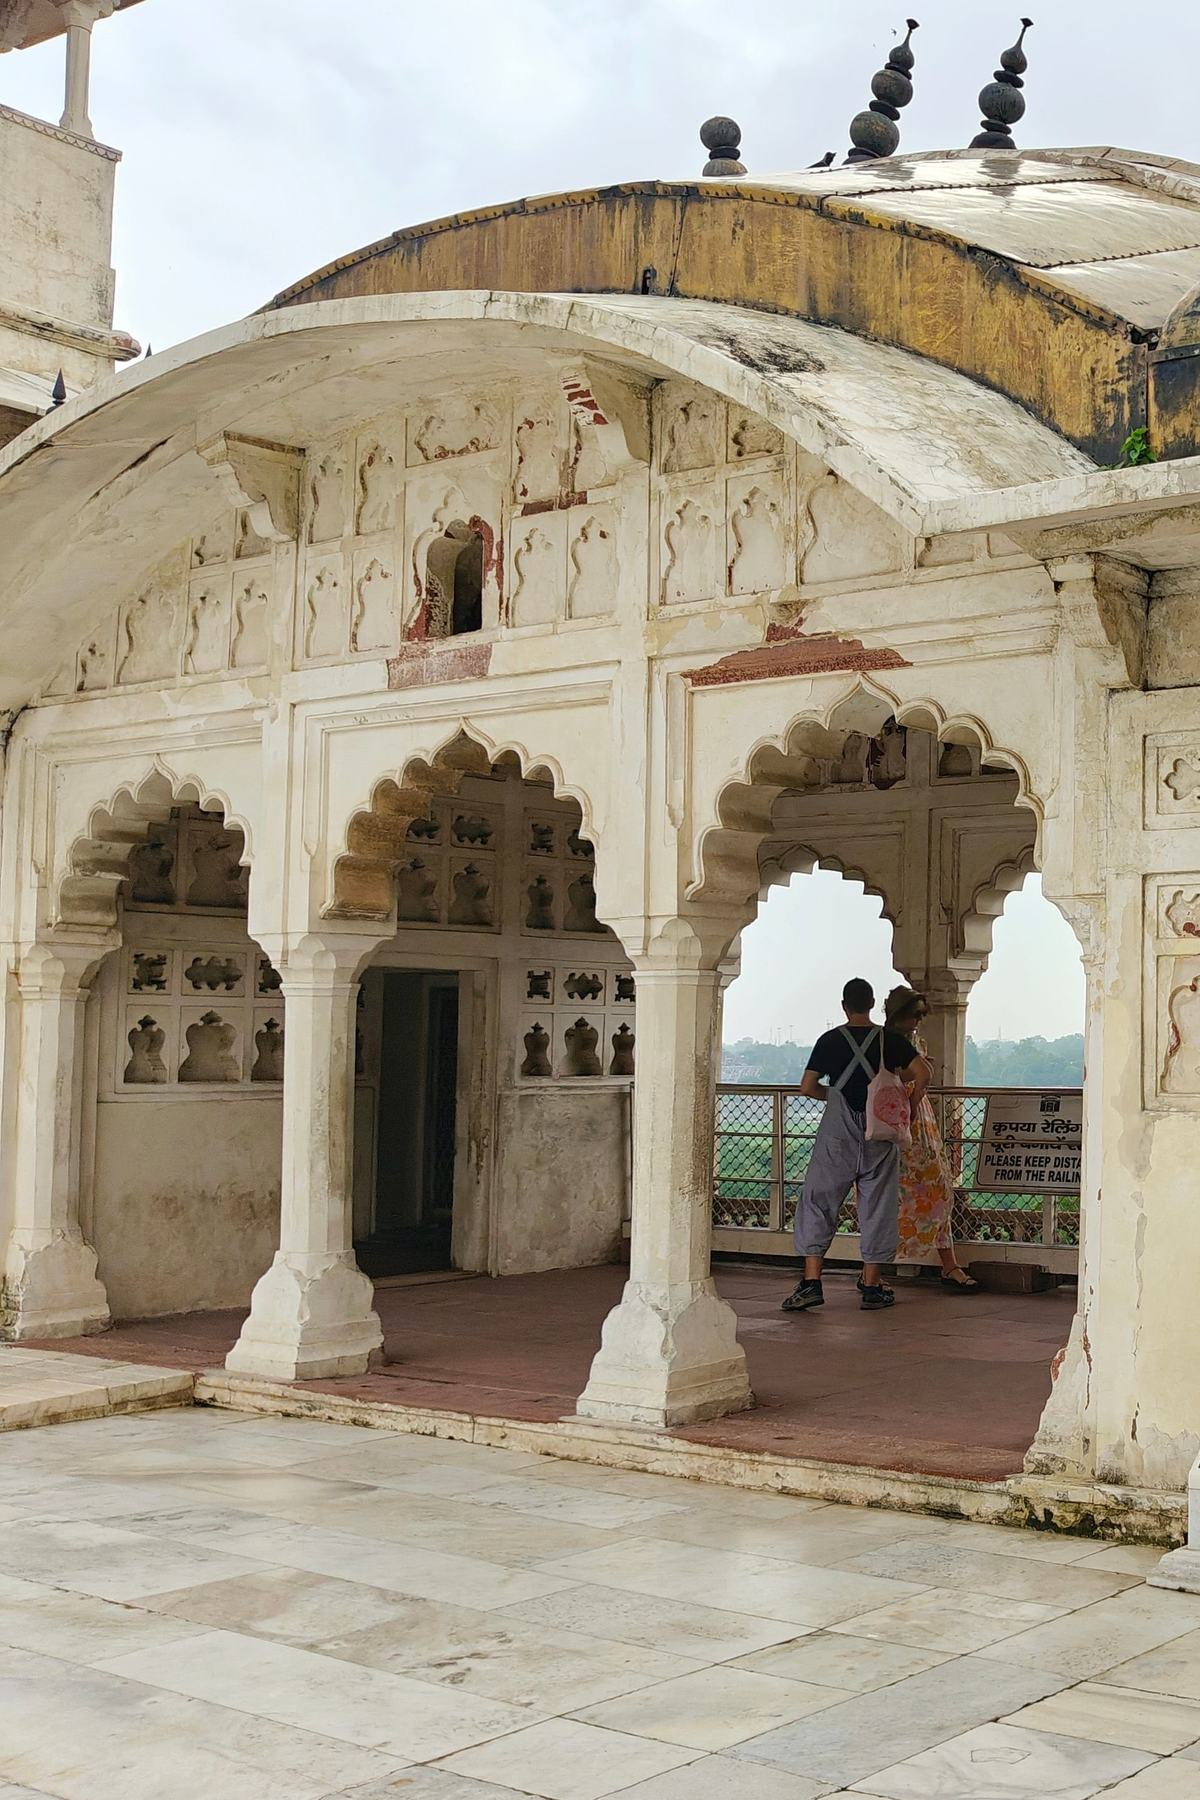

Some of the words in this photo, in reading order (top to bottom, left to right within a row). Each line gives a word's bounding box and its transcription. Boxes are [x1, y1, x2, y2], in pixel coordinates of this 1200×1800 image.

[992, 1122, 1037, 1136] कृपया
[985, 1155, 1021, 1166] PLEASE
[1024, 1157, 1050, 1168] KEEP
[994, 1169, 1021, 1180] FROM
[1025, 1170, 1045, 1182] THE
